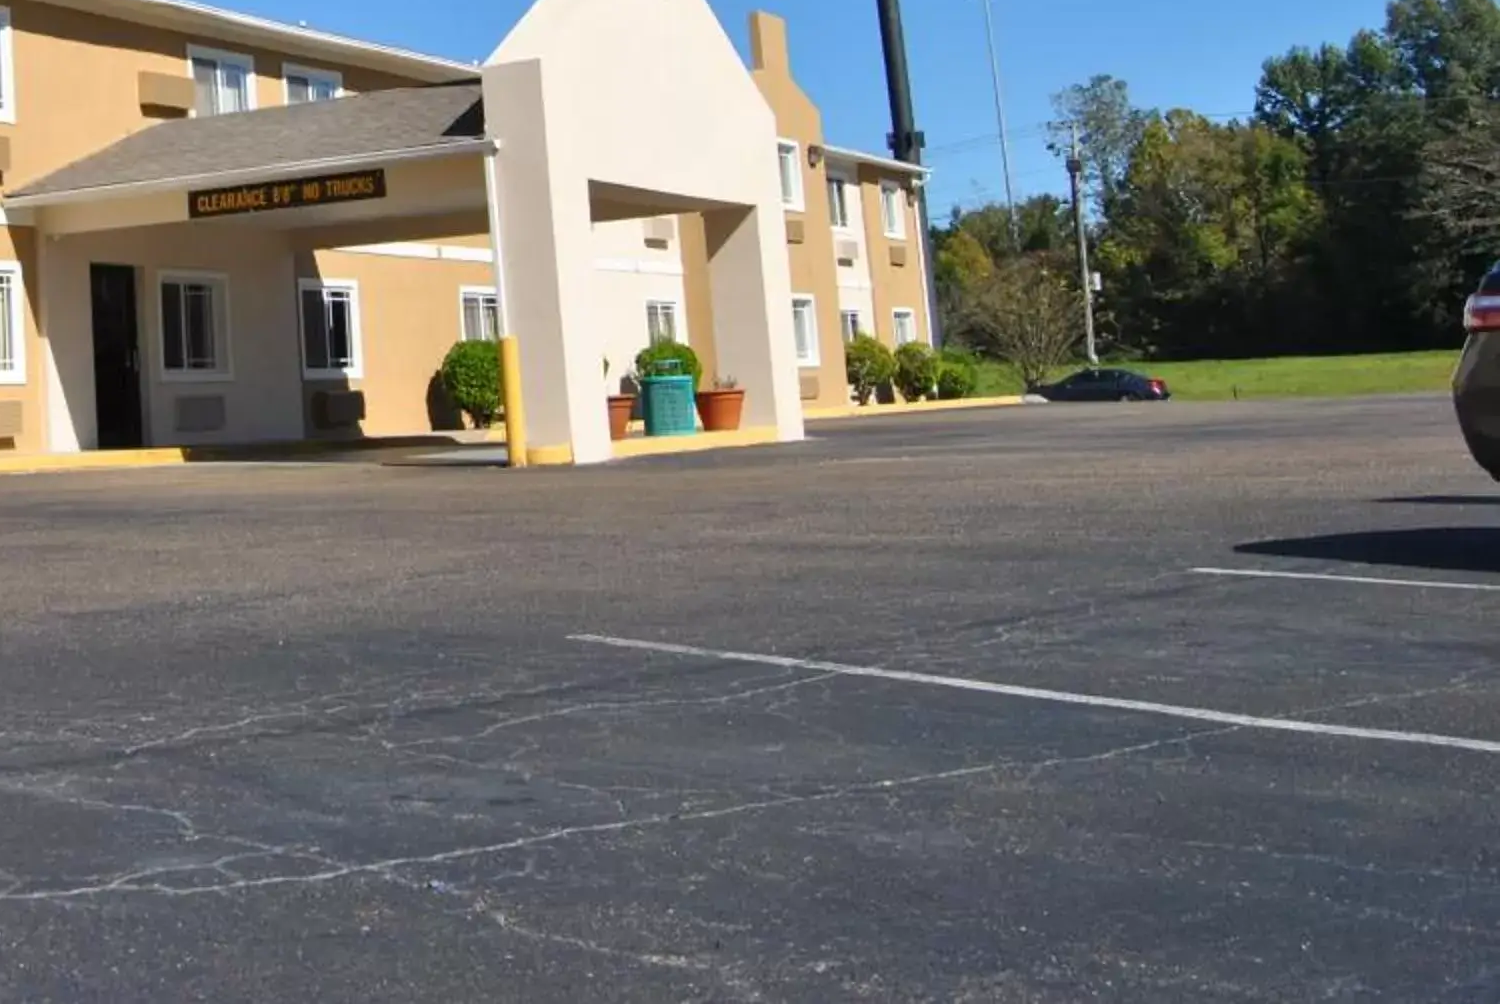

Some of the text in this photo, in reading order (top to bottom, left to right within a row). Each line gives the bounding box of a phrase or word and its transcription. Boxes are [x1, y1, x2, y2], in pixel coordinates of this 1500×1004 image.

[197, 187, 266, 212] CLEARANCE
[303, 182, 321, 200] NO
[326, 175, 375, 196] TRUCKS
